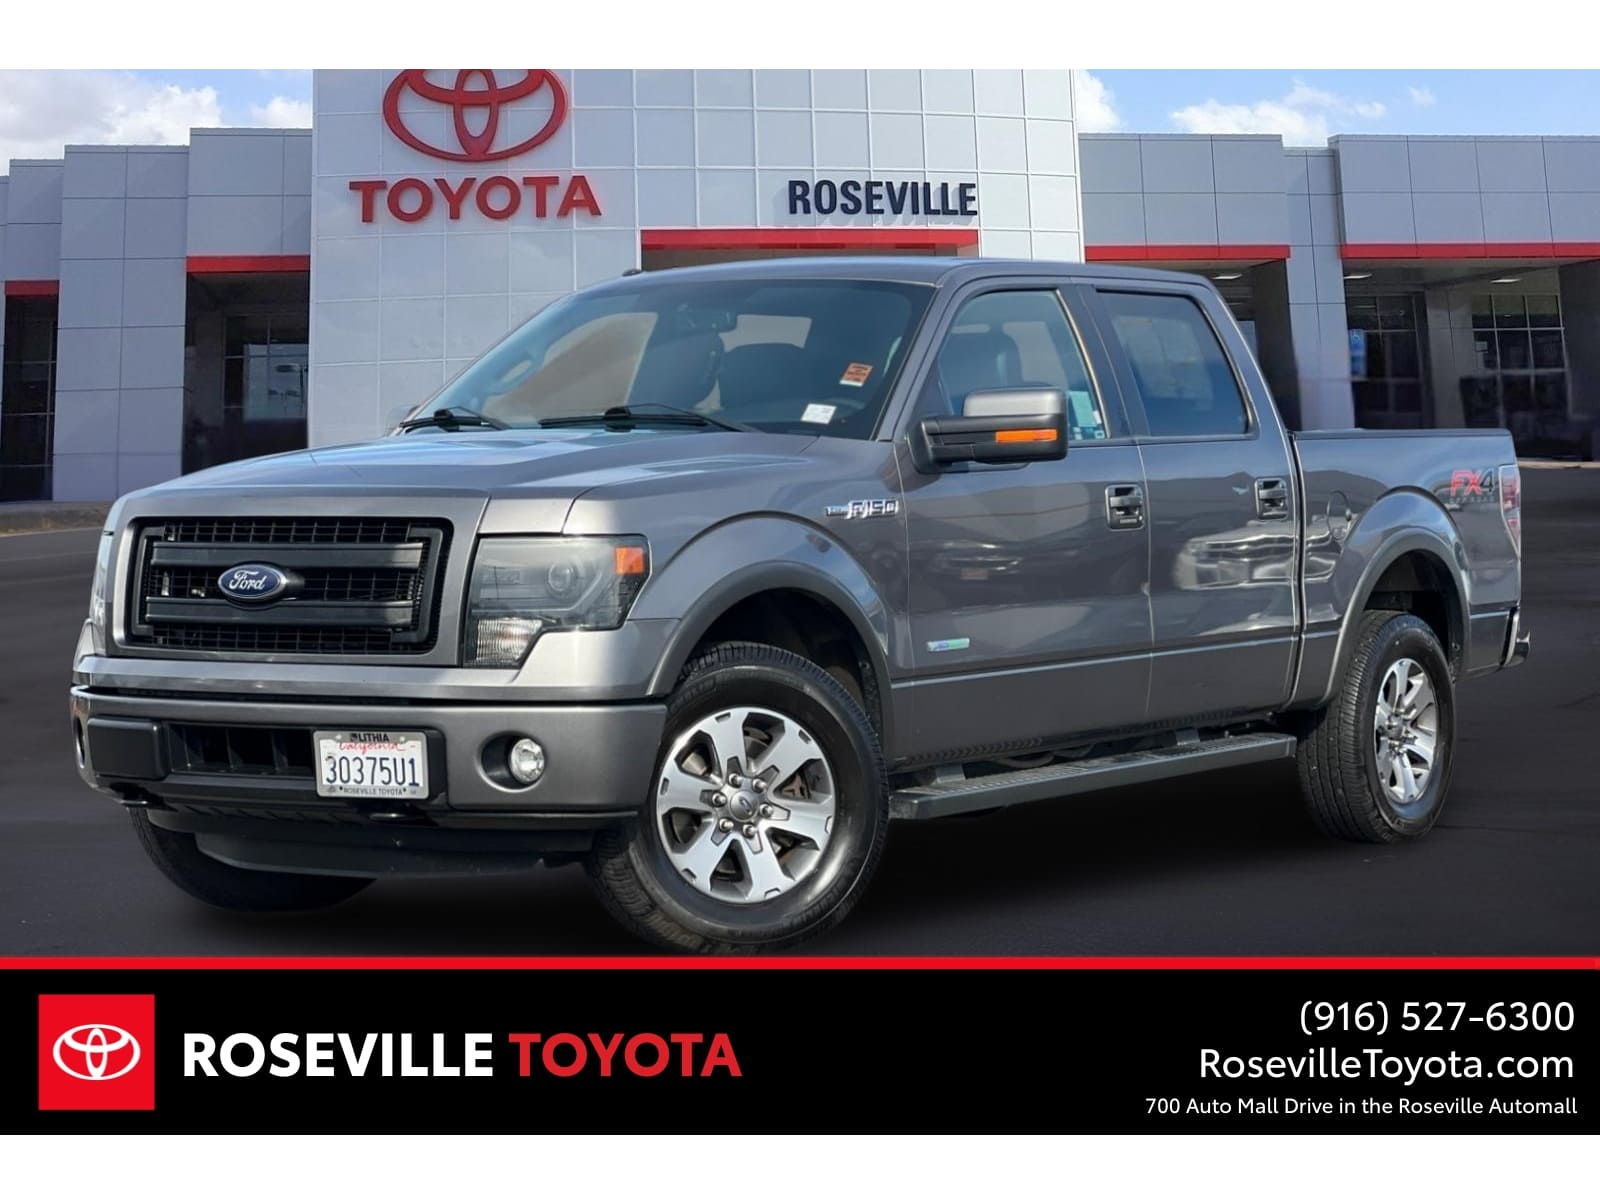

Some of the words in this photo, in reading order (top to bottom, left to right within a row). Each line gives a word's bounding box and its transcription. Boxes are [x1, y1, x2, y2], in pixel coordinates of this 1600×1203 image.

[349, 175, 602, 223] TOYOTA
[788, 180, 978, 217] ROSEVILLE
[1450, 467, 1494, 496] FX4
[229, 569, 268, 590] Ford
[357, 733, 390, 742] LITHIA
[326, 755, 420, 787] 30375U1
[343, 787, 377, 796] ROSEVILLE
[378, 788, 403, 796] TOYOTA
